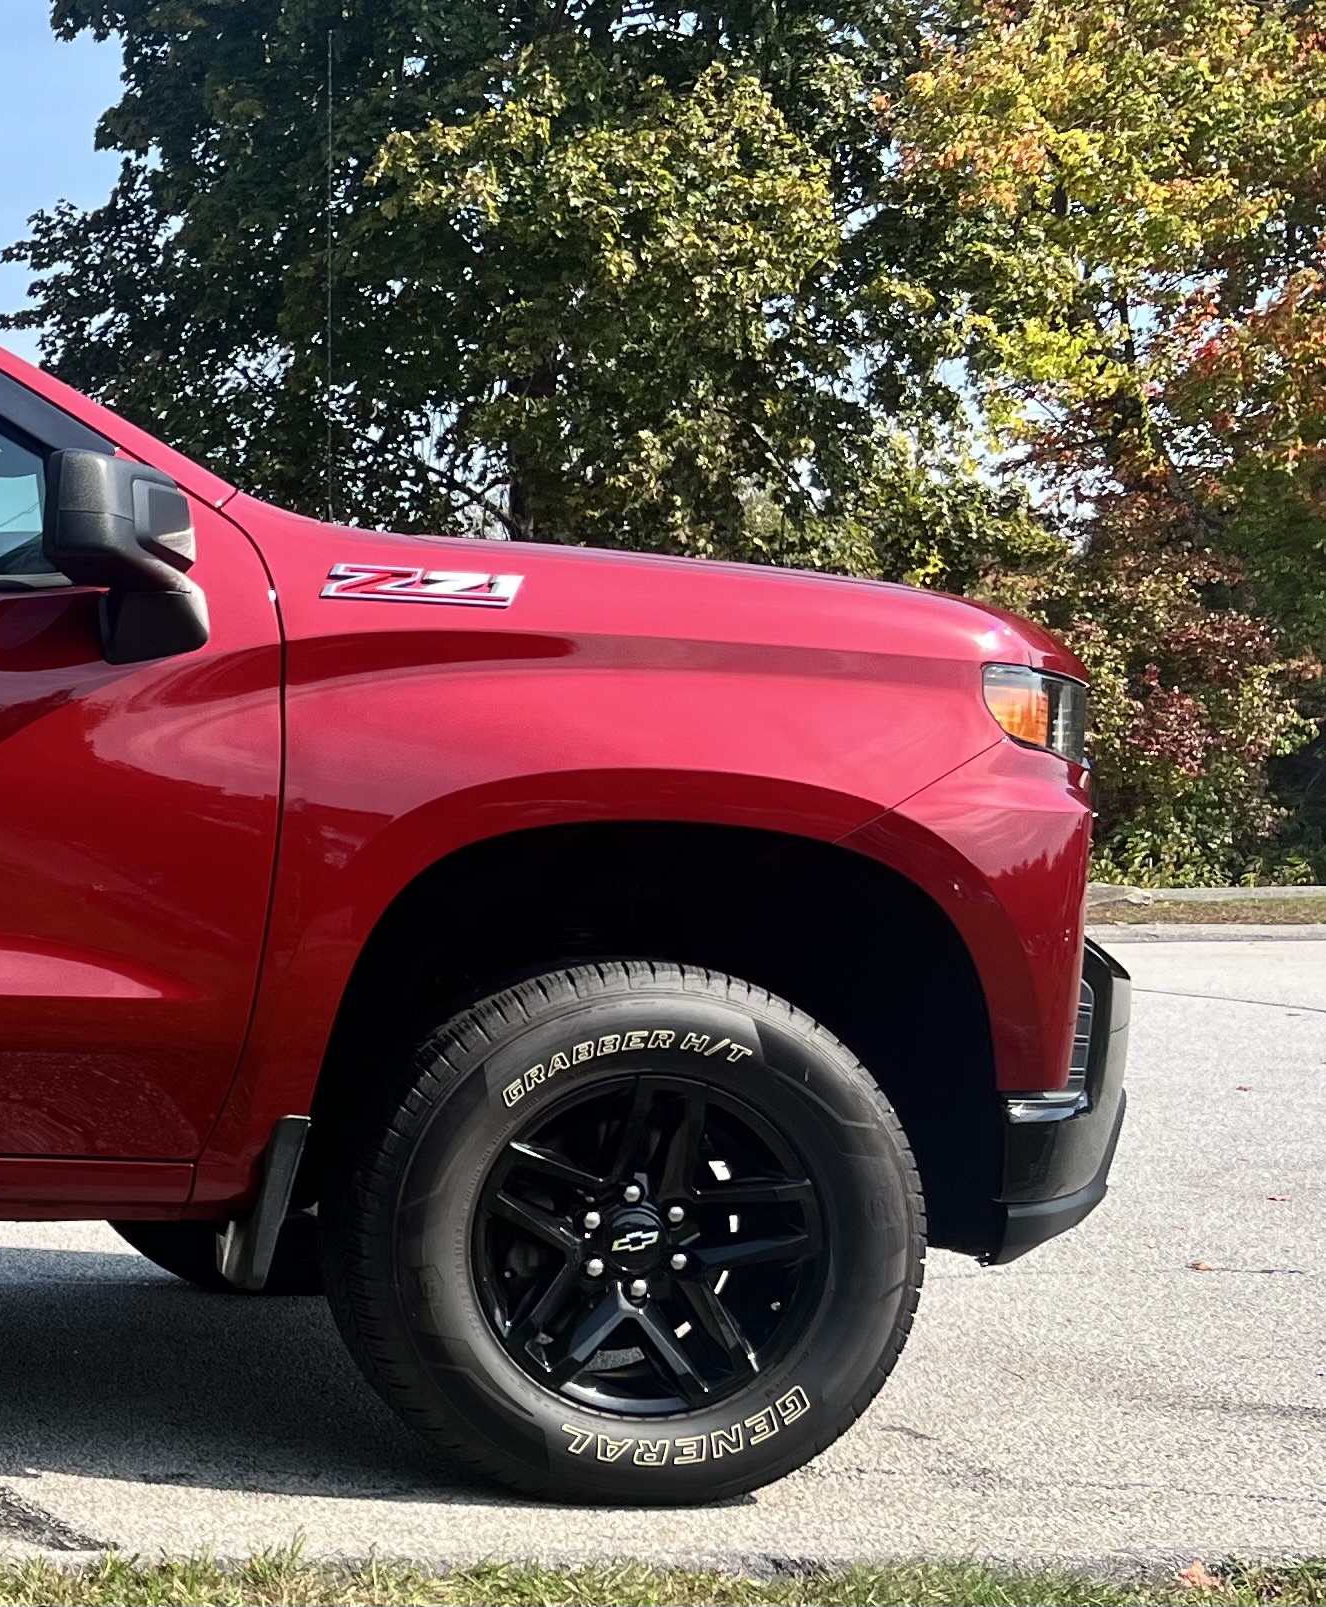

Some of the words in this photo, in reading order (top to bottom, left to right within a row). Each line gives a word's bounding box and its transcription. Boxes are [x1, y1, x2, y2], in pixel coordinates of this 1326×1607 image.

[320, 563, 525, 608] Z71
[501, 1029, 676, 1108] GRABBER
[679, 1032, 753, 1064] H/T
[561, 1385, 811, 1466] GENERAL
